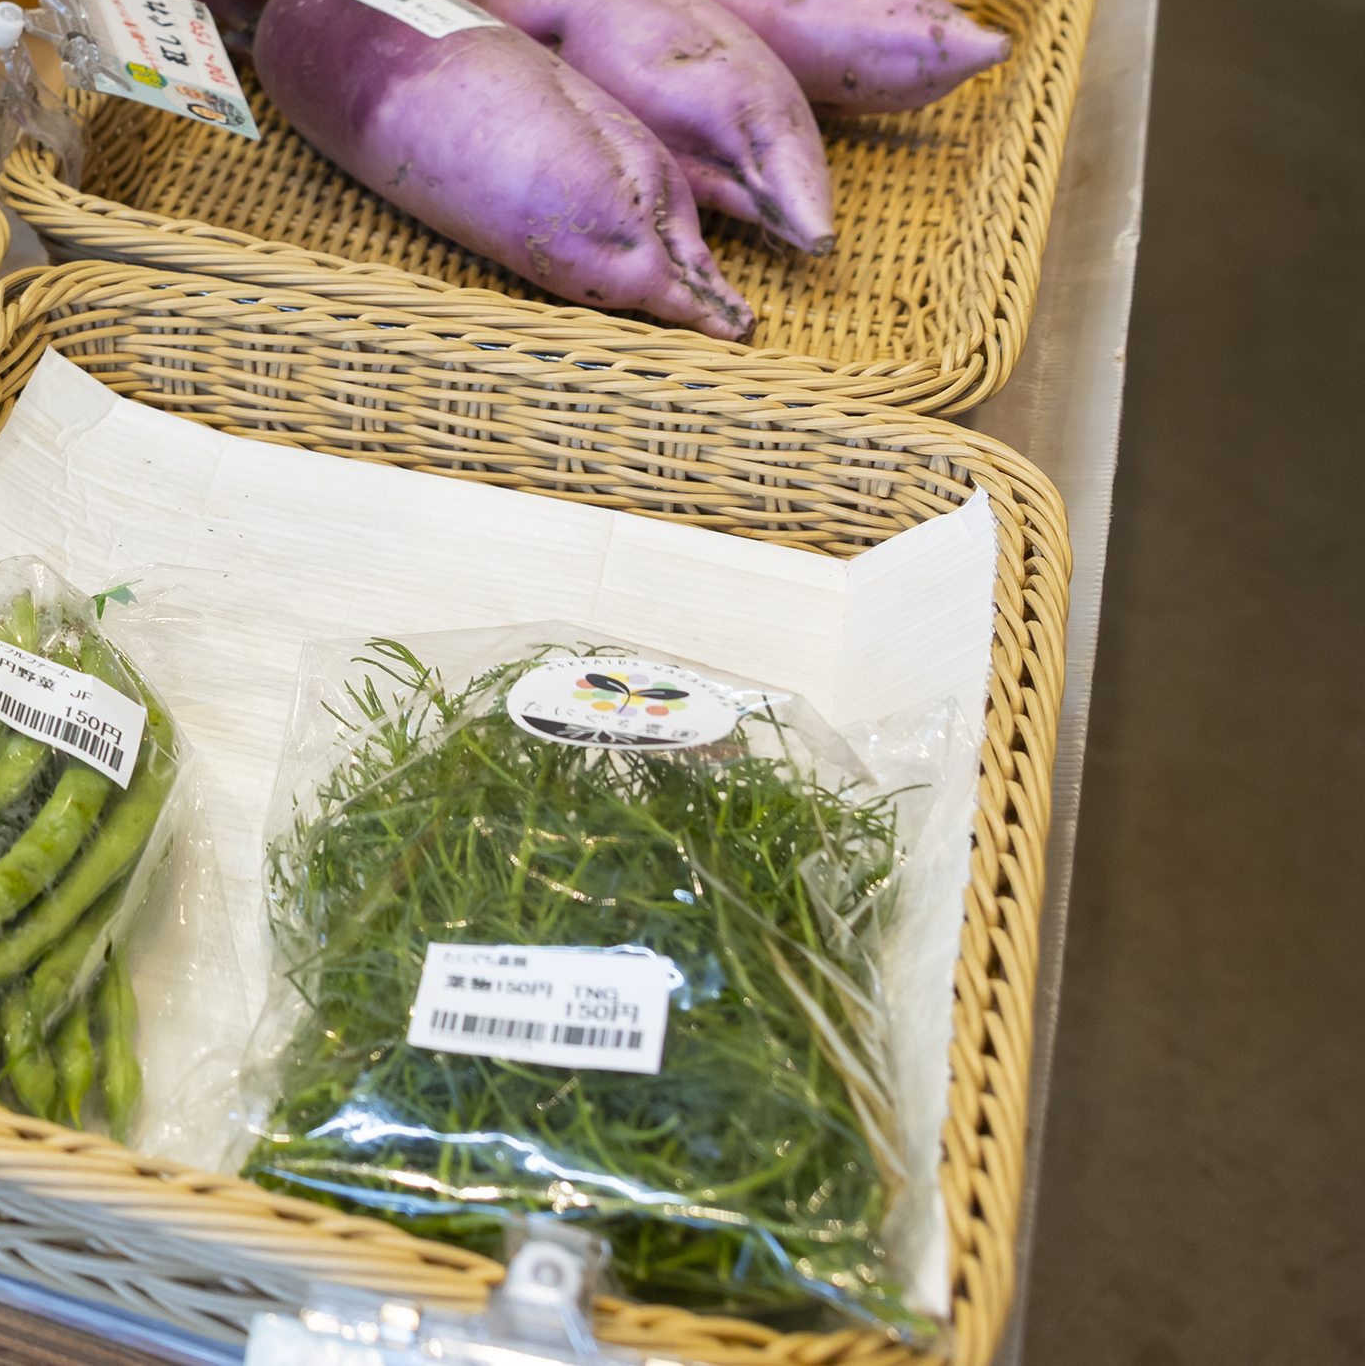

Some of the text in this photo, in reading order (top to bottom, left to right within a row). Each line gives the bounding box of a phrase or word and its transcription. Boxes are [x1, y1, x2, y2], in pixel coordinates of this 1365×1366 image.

[69, 687, 95, 703] JF
[64, 704, 124, 747] 150円
[523, 700, 700, 743] たにぐち農園
[573, 984, 621, 1002] TNG
[564, 1000, 641, 1026] 150円
